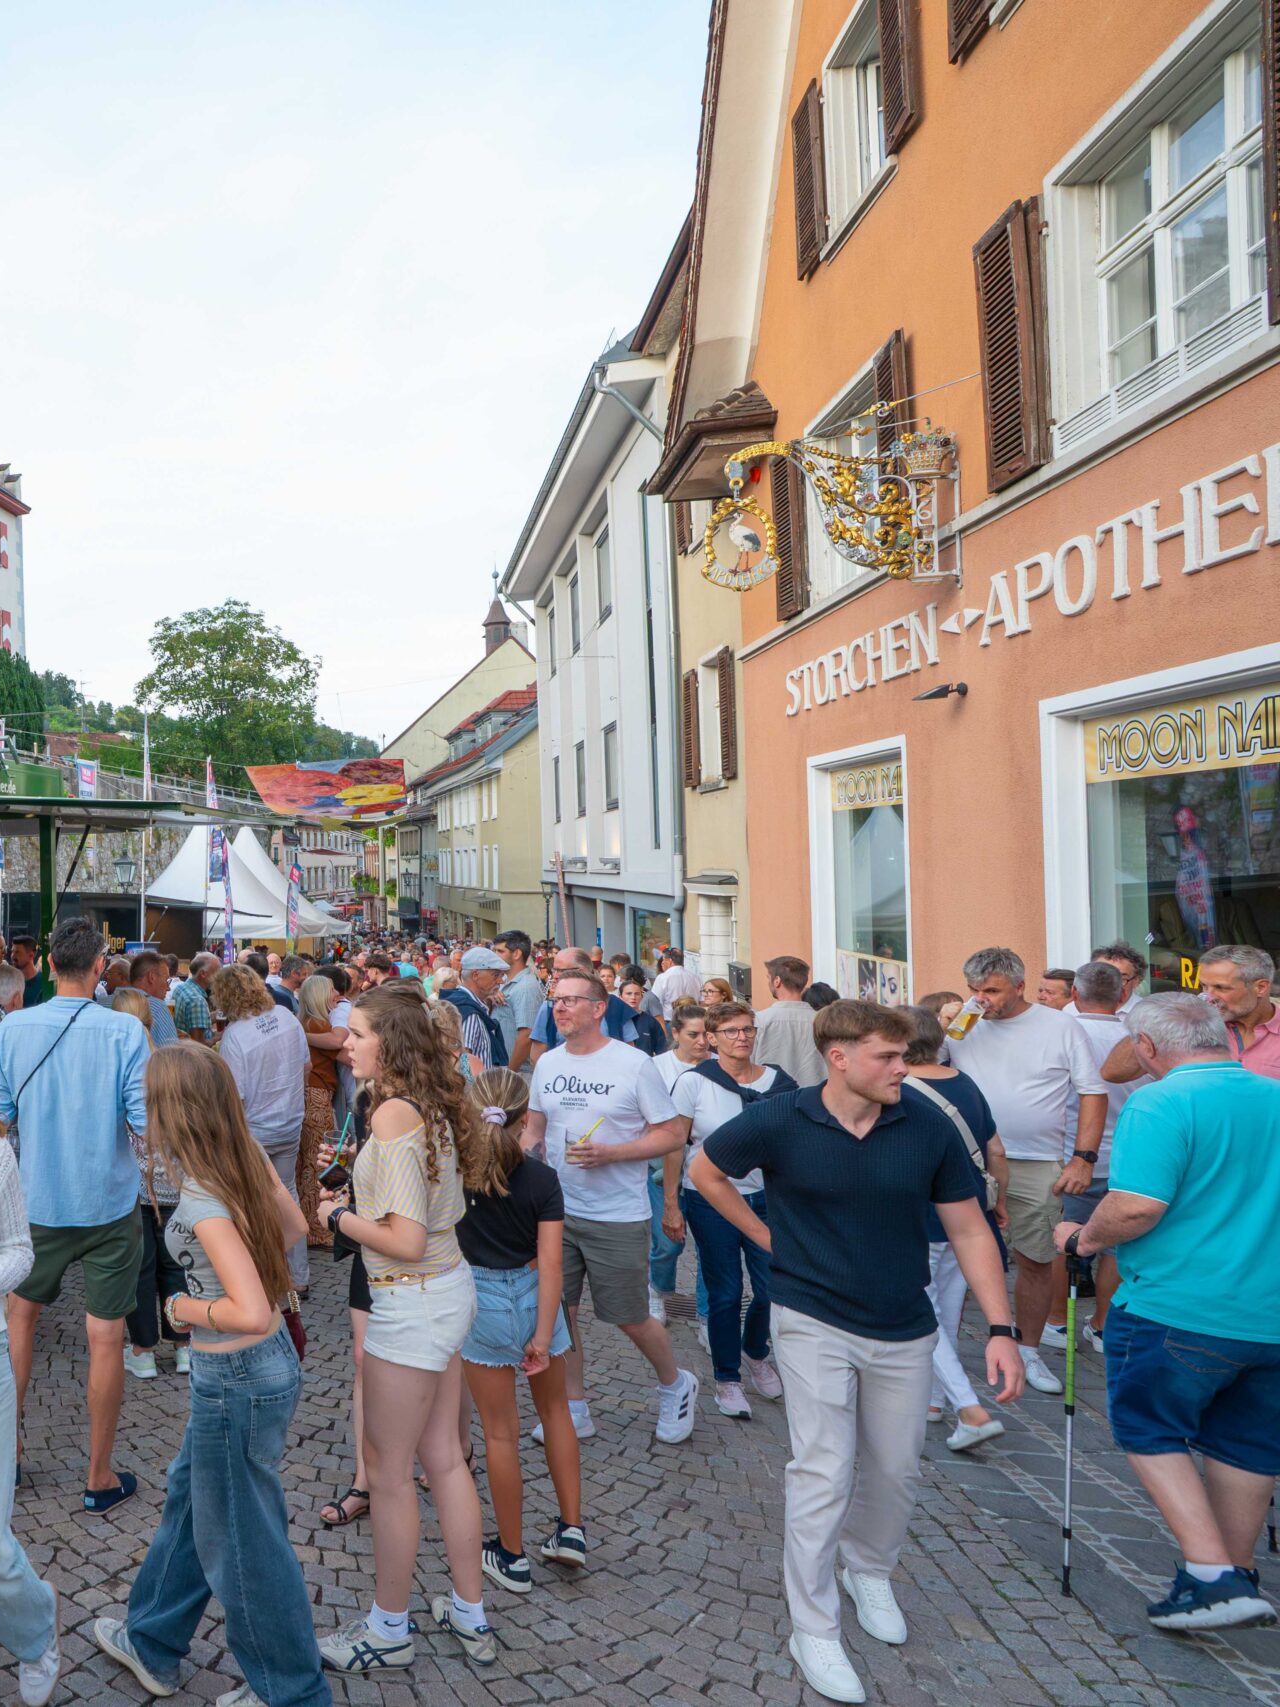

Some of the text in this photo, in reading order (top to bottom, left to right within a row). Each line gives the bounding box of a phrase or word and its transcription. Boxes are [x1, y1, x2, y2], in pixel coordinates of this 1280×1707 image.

[786, 602, 940, 716] STORCHEN
[1098, 694, 1280, 773] MOON NAI
[837, 769, 877, 804] MOON
[543, 1075, 615, 1096] s.Oliver
